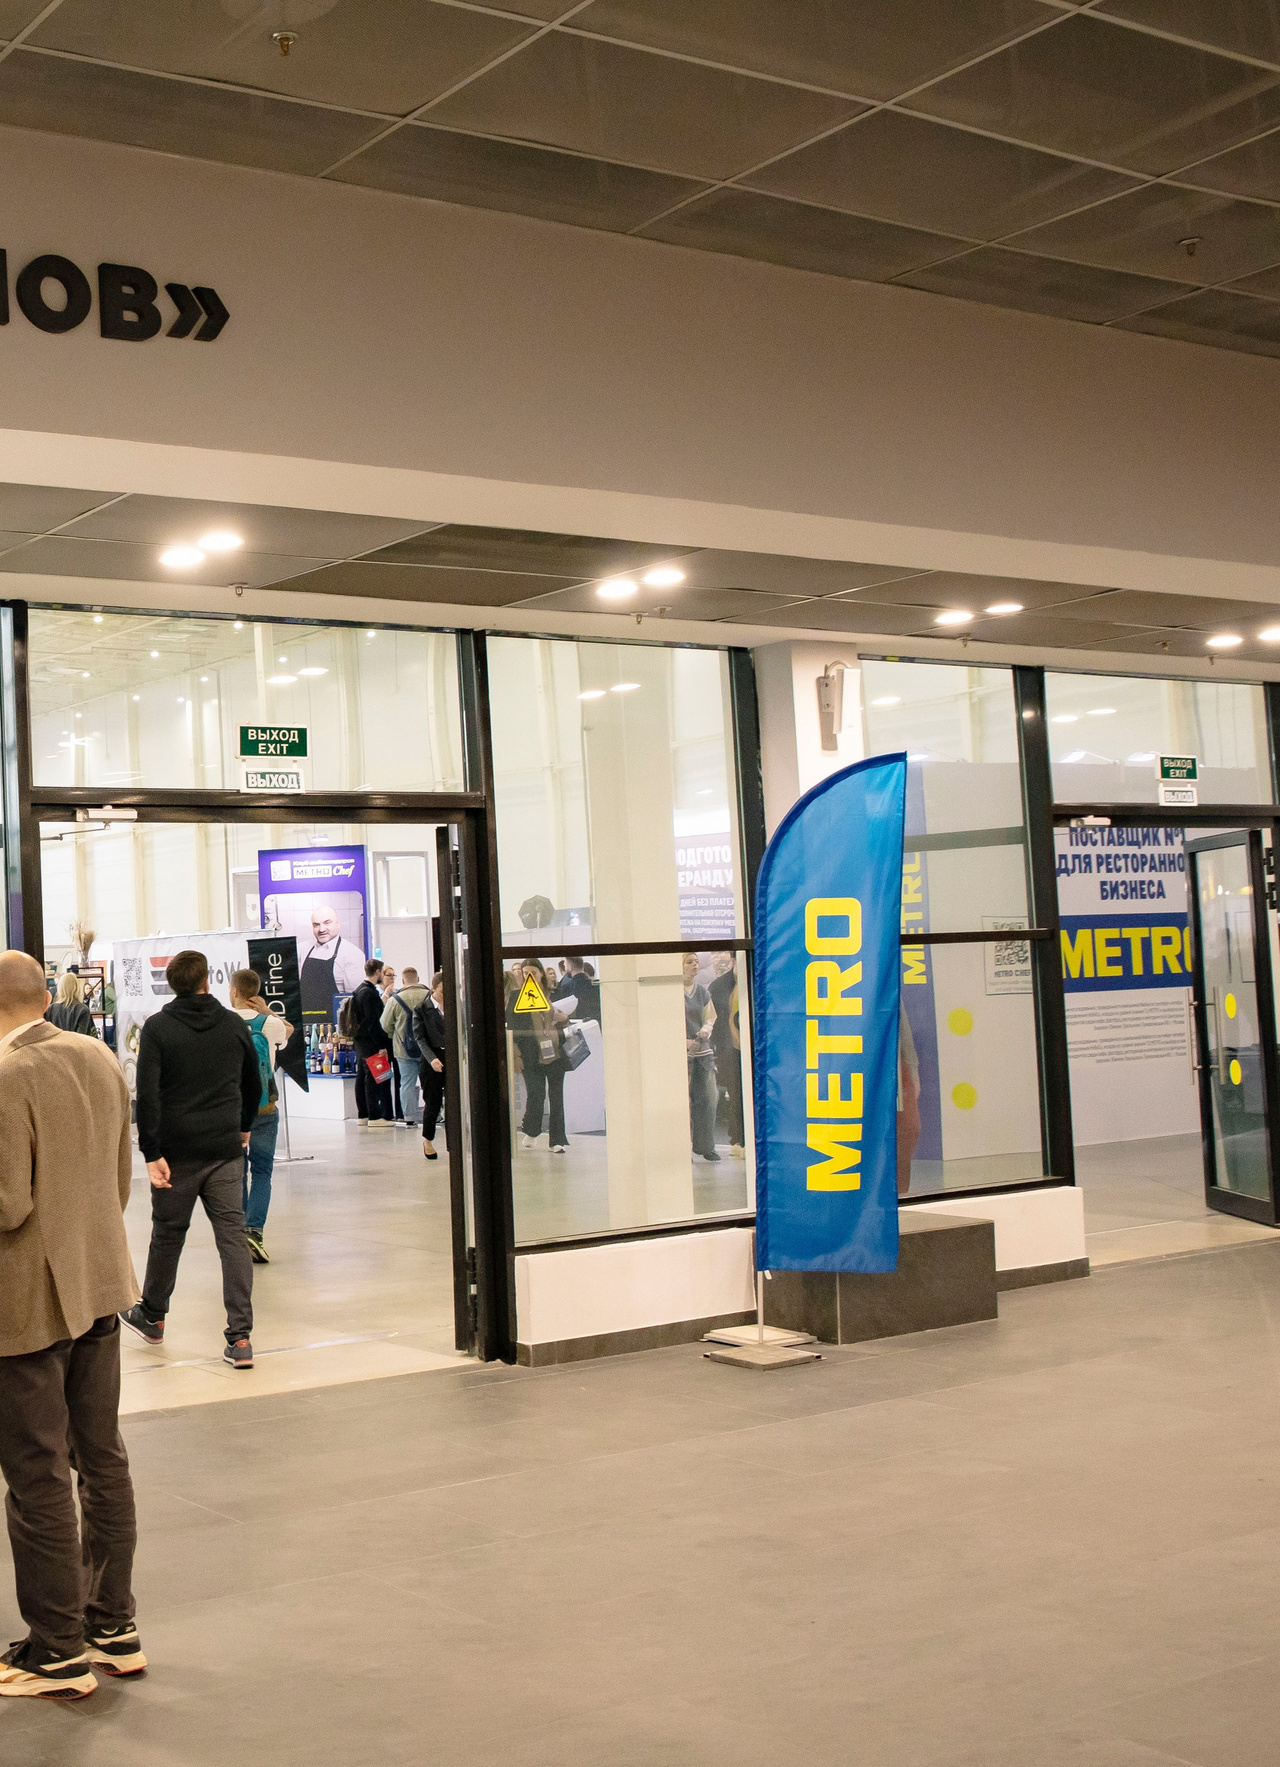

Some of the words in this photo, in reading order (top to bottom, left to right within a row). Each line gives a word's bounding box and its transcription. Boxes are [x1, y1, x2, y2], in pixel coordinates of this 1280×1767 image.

[248, 729, 299, 743] ВЫХОД
[258, 743, 289, 755] EXIT
[1164, 758, 1193, 769] ВЫХОД
[1170, 769, 1187, 778] EXIT
[247, 773, 299, 789] ВЫХОД
[1165, 791, 1194, 802] ВЫХОД
[1069, 827, 1161, 850] ПОСТАВЩИК
[295, 868, 330, 877] METRO
[332, 864, 355, 878] Chef
[1056, 853, 1092, 878] ДЛЯ
[1100, 879, 1167, 901] БИЗНЕСА
[265, 953, 285, 997] Fine
[994, 969, 1013, 978] METRO
[805, 897, 863, 1192] METRO
